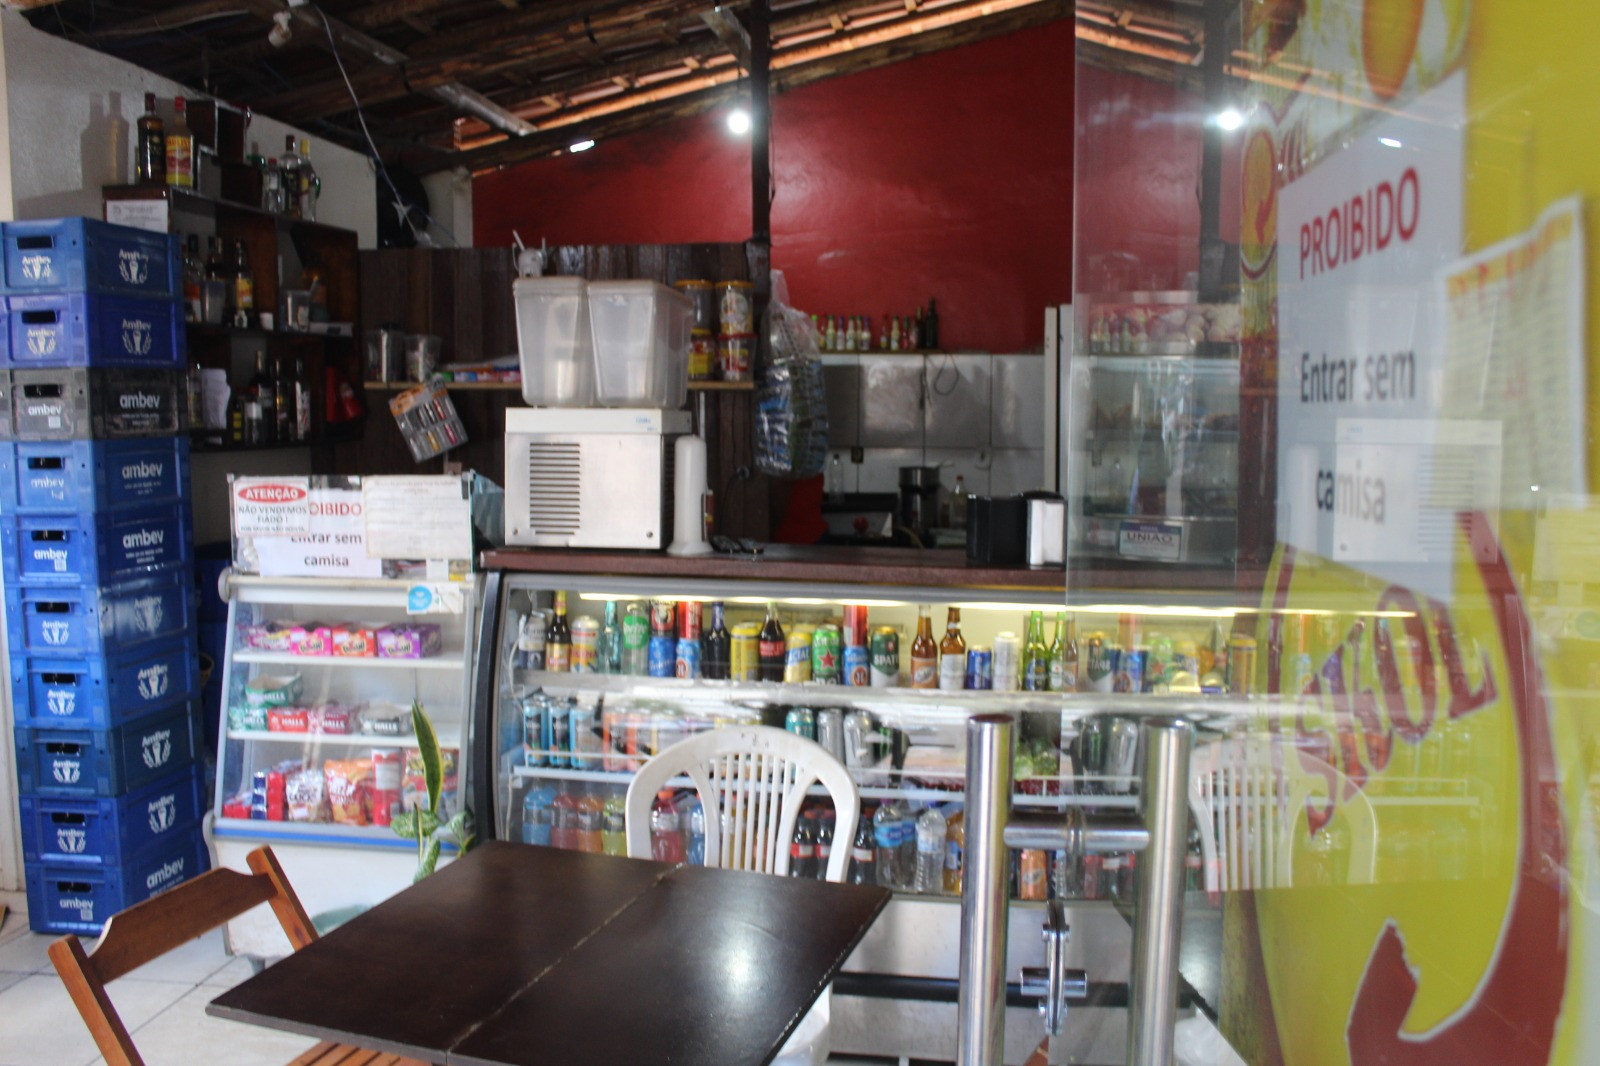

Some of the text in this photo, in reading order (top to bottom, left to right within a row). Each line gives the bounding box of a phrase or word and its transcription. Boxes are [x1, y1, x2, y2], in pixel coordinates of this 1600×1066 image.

[1299, 167, 1420, 280] PROIBIDO
[1301, 350, 1416, 404] Entrar sem
[120, 391, 160, 409] ambev
[28, 404, 61, 416] ambev
[122, 460, 162, 479] ambev
[246, 488, 298, 501] ATENÇÃO
[1317, 460, 1386, 525] camisa
[309, 502, 362, 516] OIBIDO
[123, 529, 163, 548] ambev
[335, 532, 362, 544] sem
[34, 548, 67, 560] ambev
[304, 553, 349, 566] camisa
[147, 858, 184, 889] ambev
[60, 897, 93, 909] ambev
